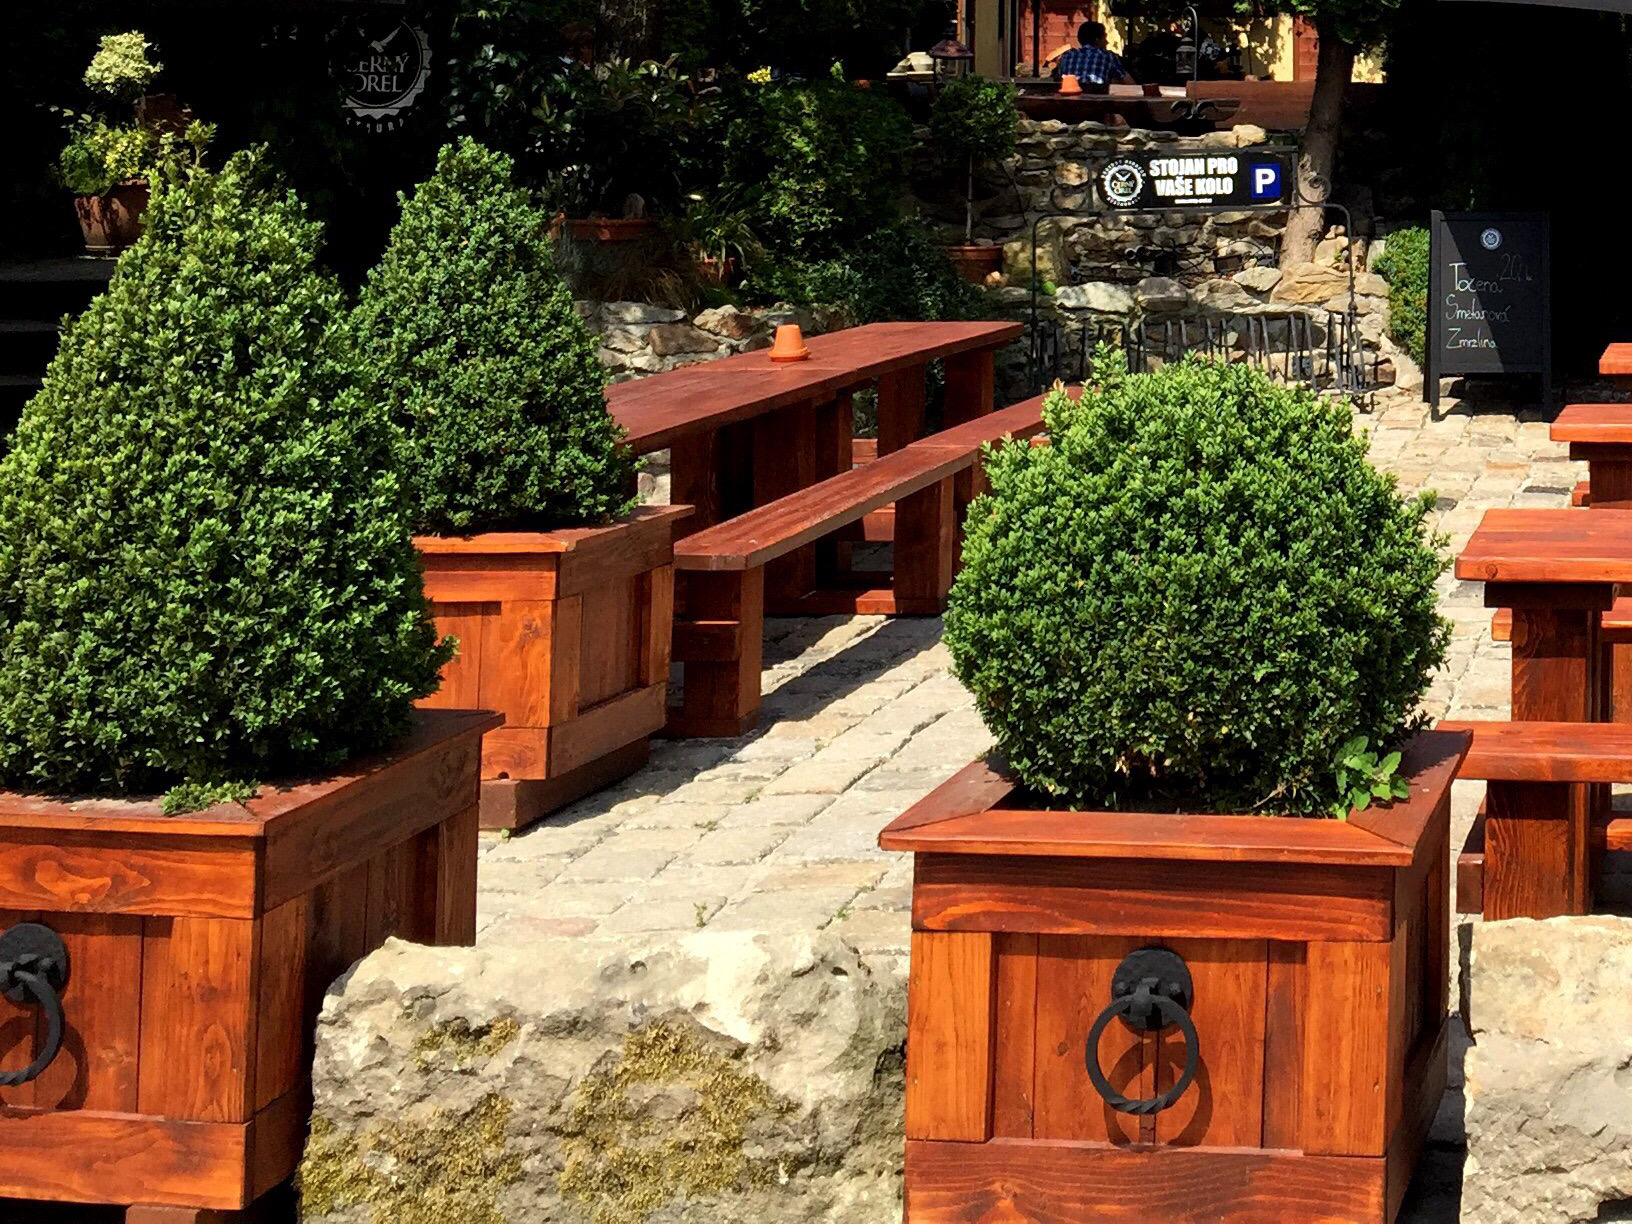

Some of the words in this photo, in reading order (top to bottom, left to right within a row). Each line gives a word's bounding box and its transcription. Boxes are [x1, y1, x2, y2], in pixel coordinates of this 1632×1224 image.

[1149, 158, 1205, 177] STOJAN
[1207, 157, 1238, 175] PRO
[1155, 176, 1194, 196] VAŠE
[1195, 177, 1233, 195] KOLO
[1255, 168, 1276, 194] P
